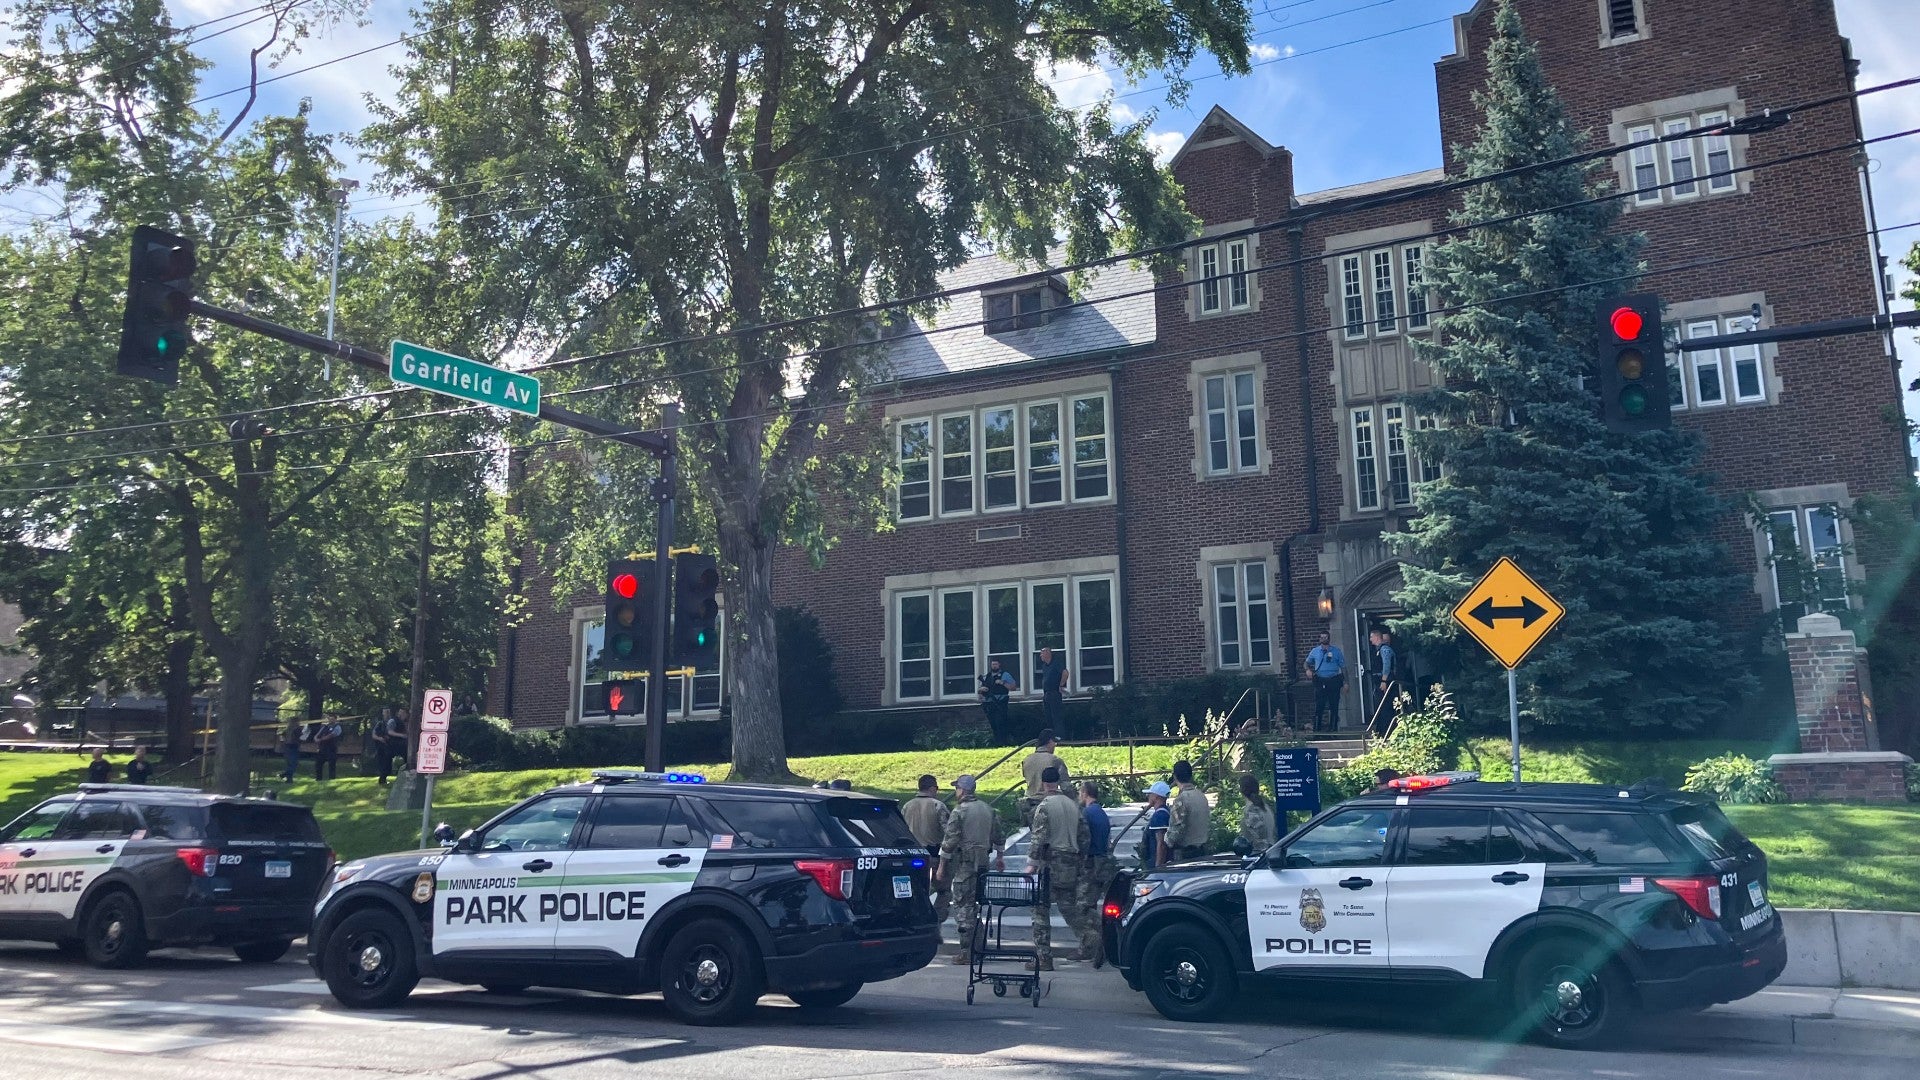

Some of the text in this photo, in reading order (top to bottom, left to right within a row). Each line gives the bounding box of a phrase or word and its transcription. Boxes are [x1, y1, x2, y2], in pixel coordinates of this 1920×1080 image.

[402, 354, 531, 404] Garfield Av
[219, 855, 242, 865] 820
[418, 855, 444, 866] 850
[858, 858, 878, 870] 850
[25, 871, 84, 894] POLICE
[449, 877, 517, 890] MINNEAPOLIS
[1221, 873, 1246, 884] 431
[1721, 872, 1738, 888] 431
[446, 891, 646, 925] PARK POLICE
[1265, 938, 1372, 955] POLICE
